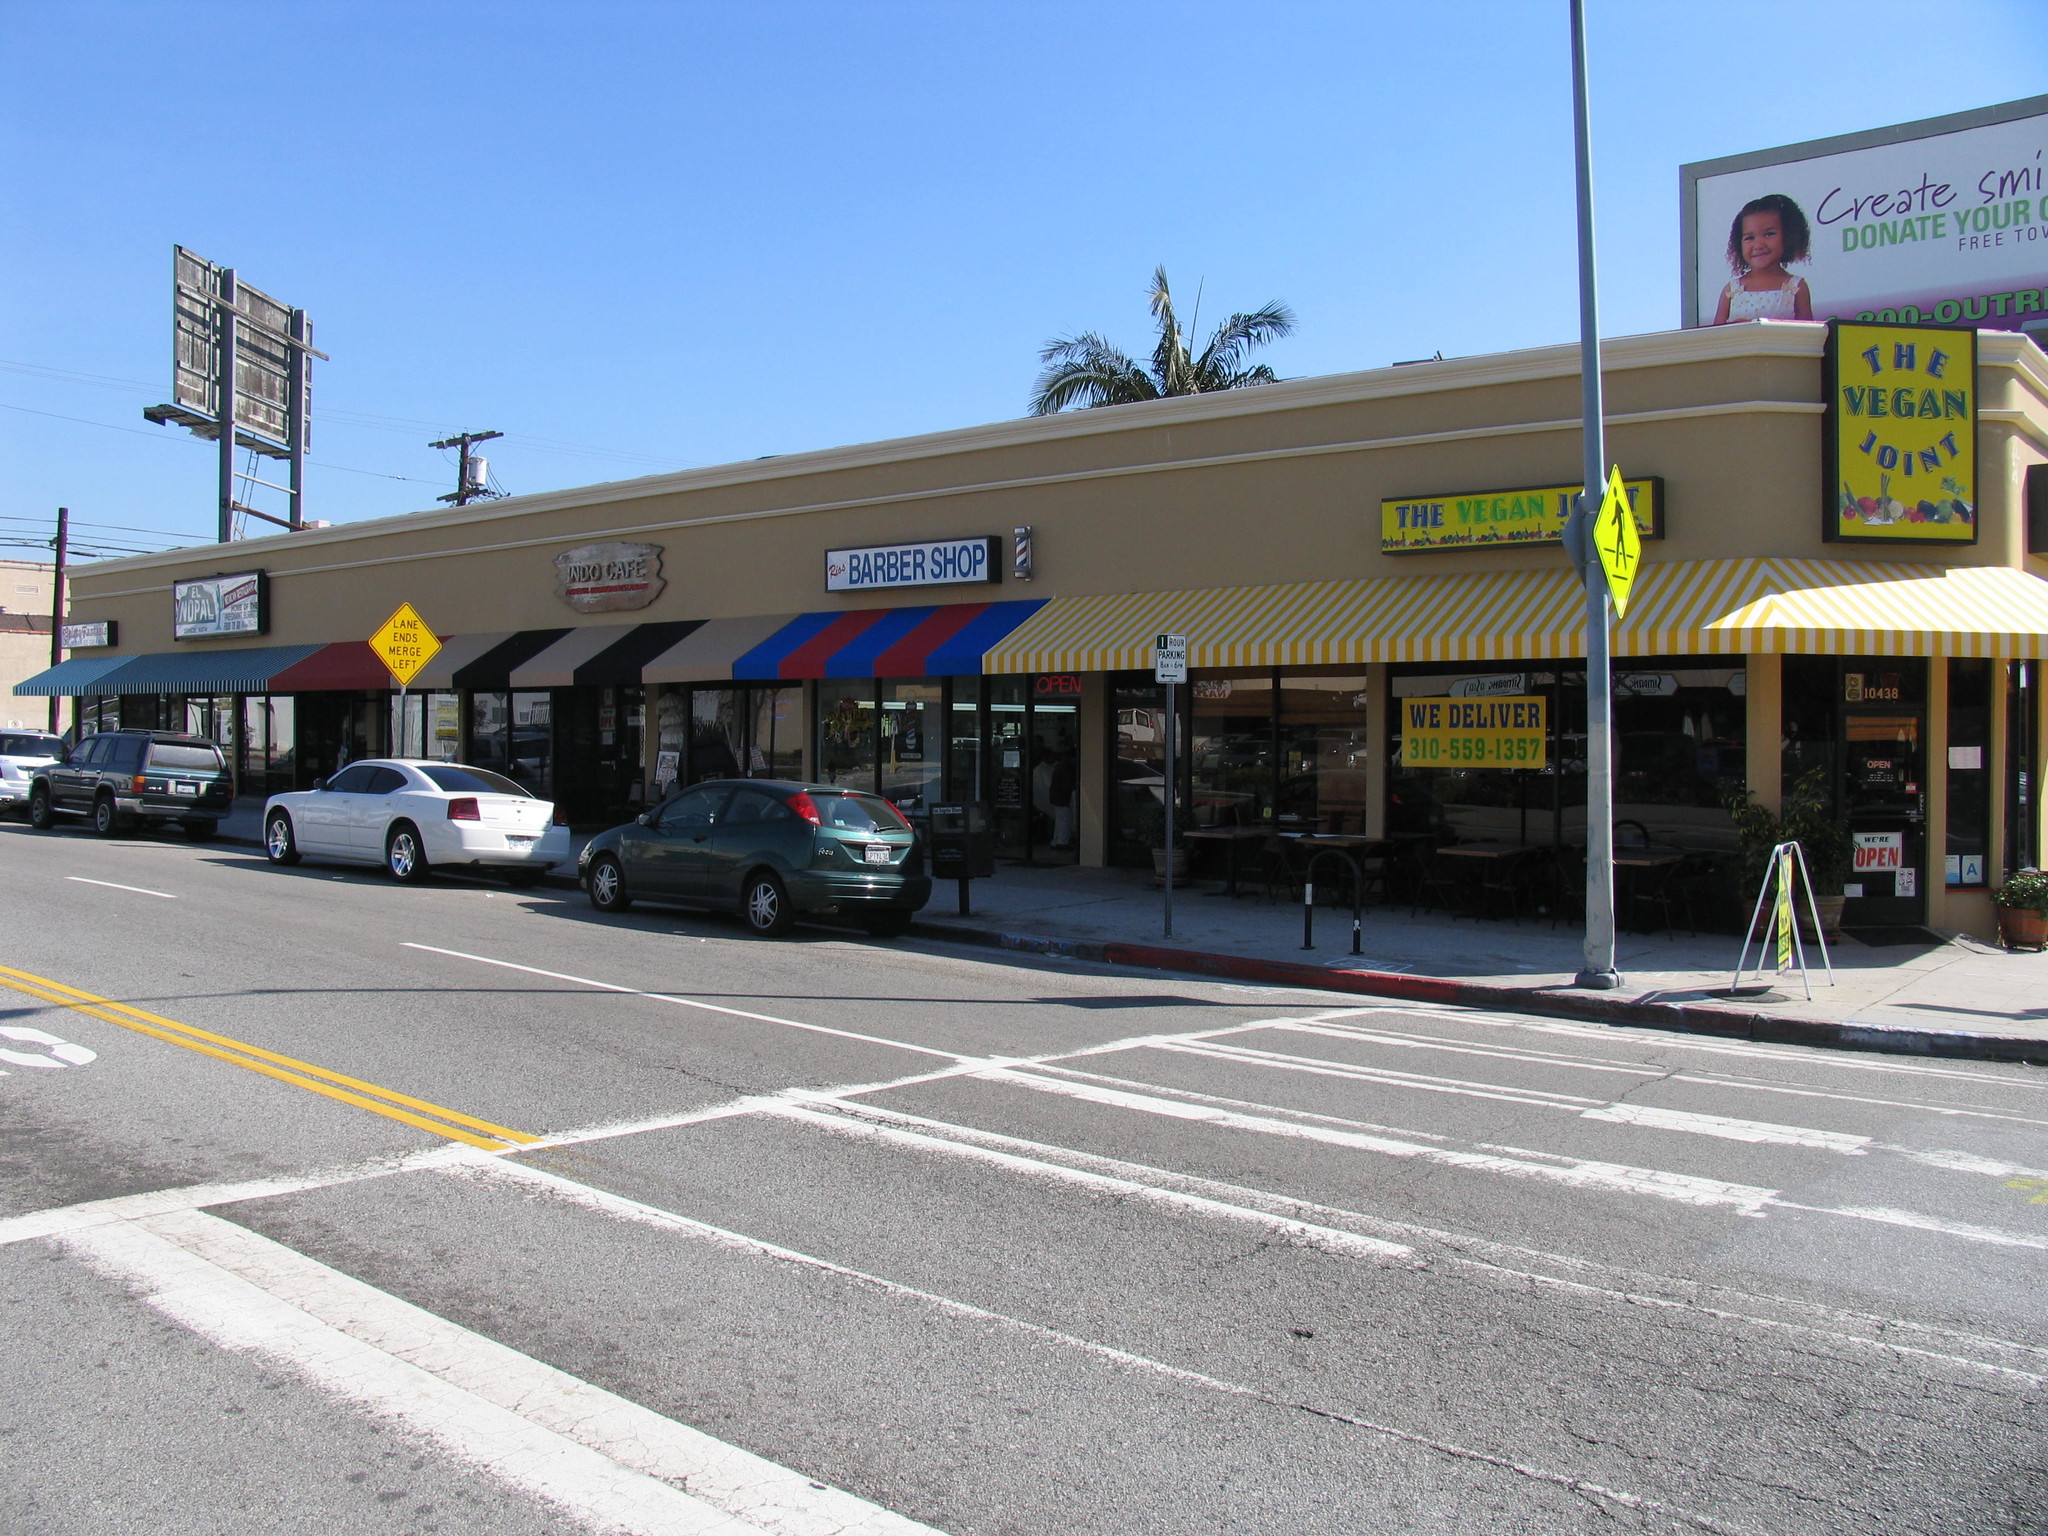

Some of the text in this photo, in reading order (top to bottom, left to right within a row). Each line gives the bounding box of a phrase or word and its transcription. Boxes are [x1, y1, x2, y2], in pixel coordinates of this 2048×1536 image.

[1816, 172, 1957, 225] Create
[1842, 213, 1946, 252] DONATE
[1953, 199, 2030, 235] YOUR
[1959, 232, 2003, 252] FREE
[1861, 341, 1950, 379] THE
[1841, 384, 1968, 420] VEGAN
[1858, 428, 1960, 477] JOINT
[1395, 502, 1444, 529] THE
[1456, 494, 1545, 525] VEGAN
[606, 558, 647, 580] CAFE
[828, 543, 985, 585] Rios BARBER SHOP
[191, 586, 202, 598] EL
[178, 598, 215, 623] NOPAL
[393, 619, 419, 629] LANE
[393, 632, 418, 643] ENDS
[1168, 637, 1185, 647] HOUR
[388, 646, 422, 656] MERGE
[1158, 650, 1185, 660] PARKING
[393, 659, 417, 669] LEFT
[1036, 675, 1082, 693] OPEN
[1863, 687, 1899, 699] 10438
[1409, 702, 1541, 729] WE DELIVER
[1409, 737, 1541, 761] 310-559-1357
[1866, 760, 1891, 769] OPEN
[1864, 836, 1890, 844] WE'RE
[1855, 847, 1899, 868] OPEN
[1966, 862, 1978, 876] A
